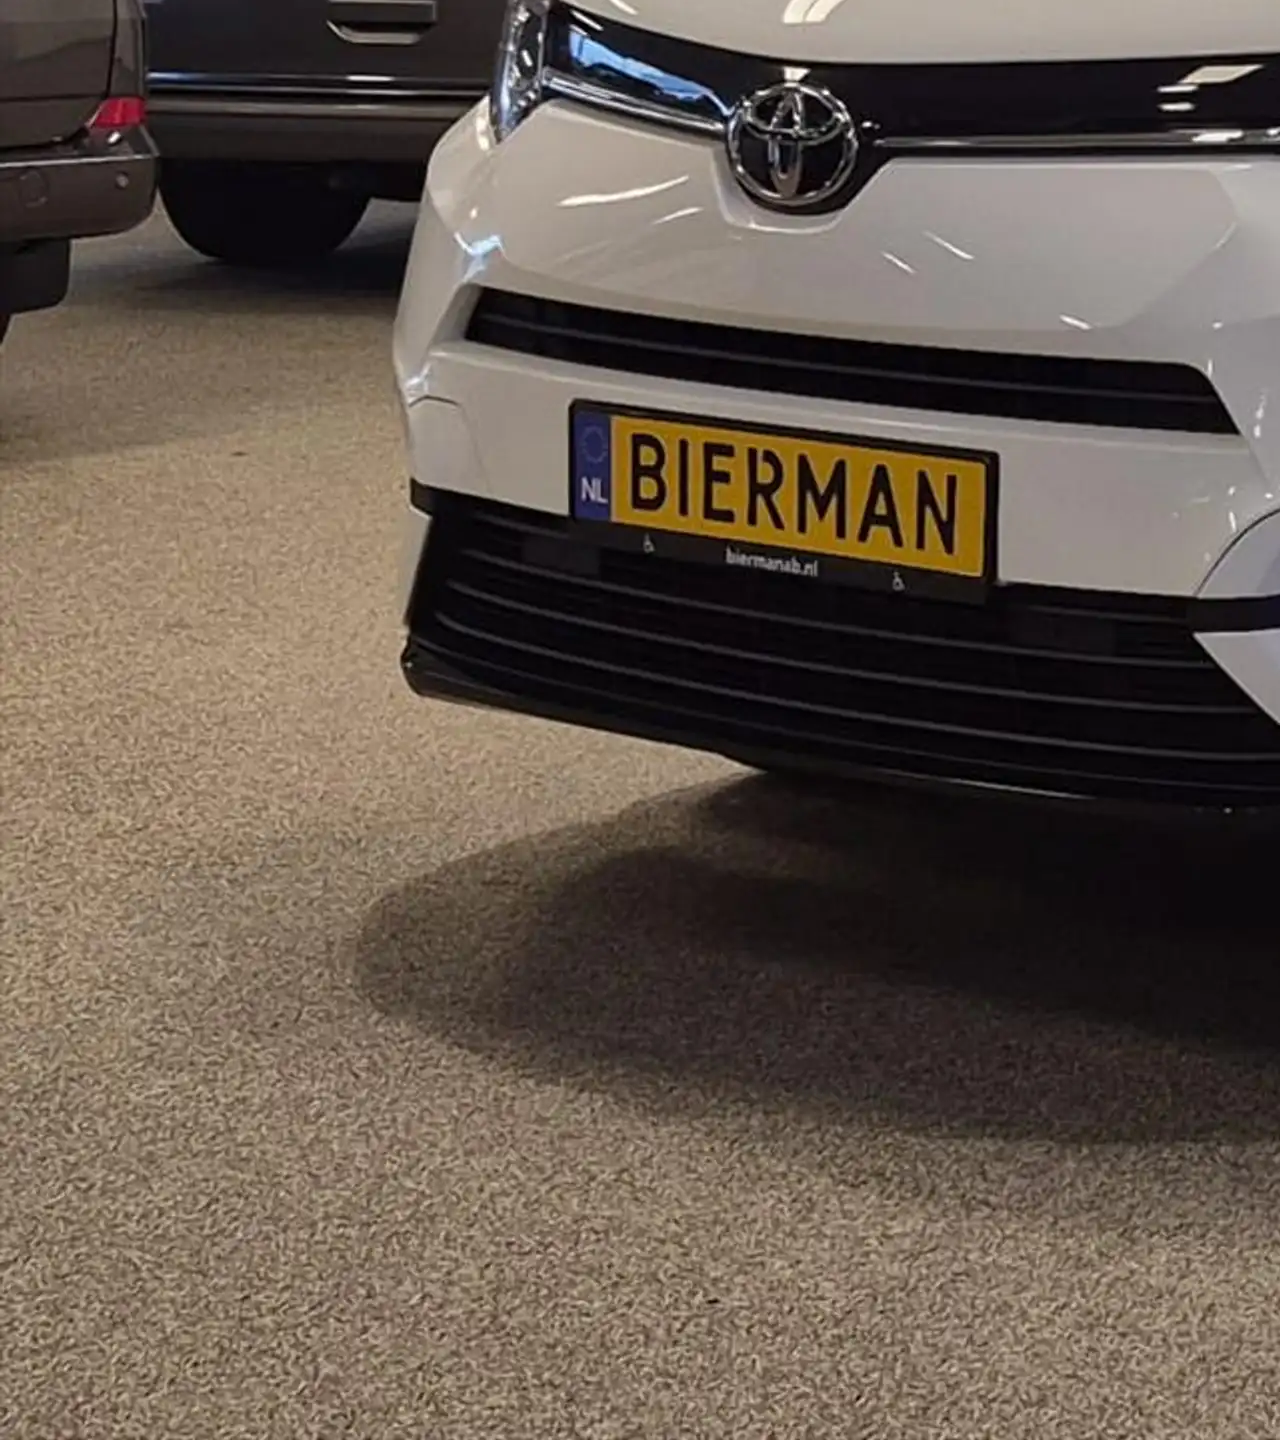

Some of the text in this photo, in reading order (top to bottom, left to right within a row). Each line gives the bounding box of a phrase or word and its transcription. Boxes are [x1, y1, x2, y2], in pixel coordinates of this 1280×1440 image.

[580, 476, 609, 505] NL
[630, 432, 958, 556] BIERMAN
[725, 544, 819, 578] biermanab.nl
